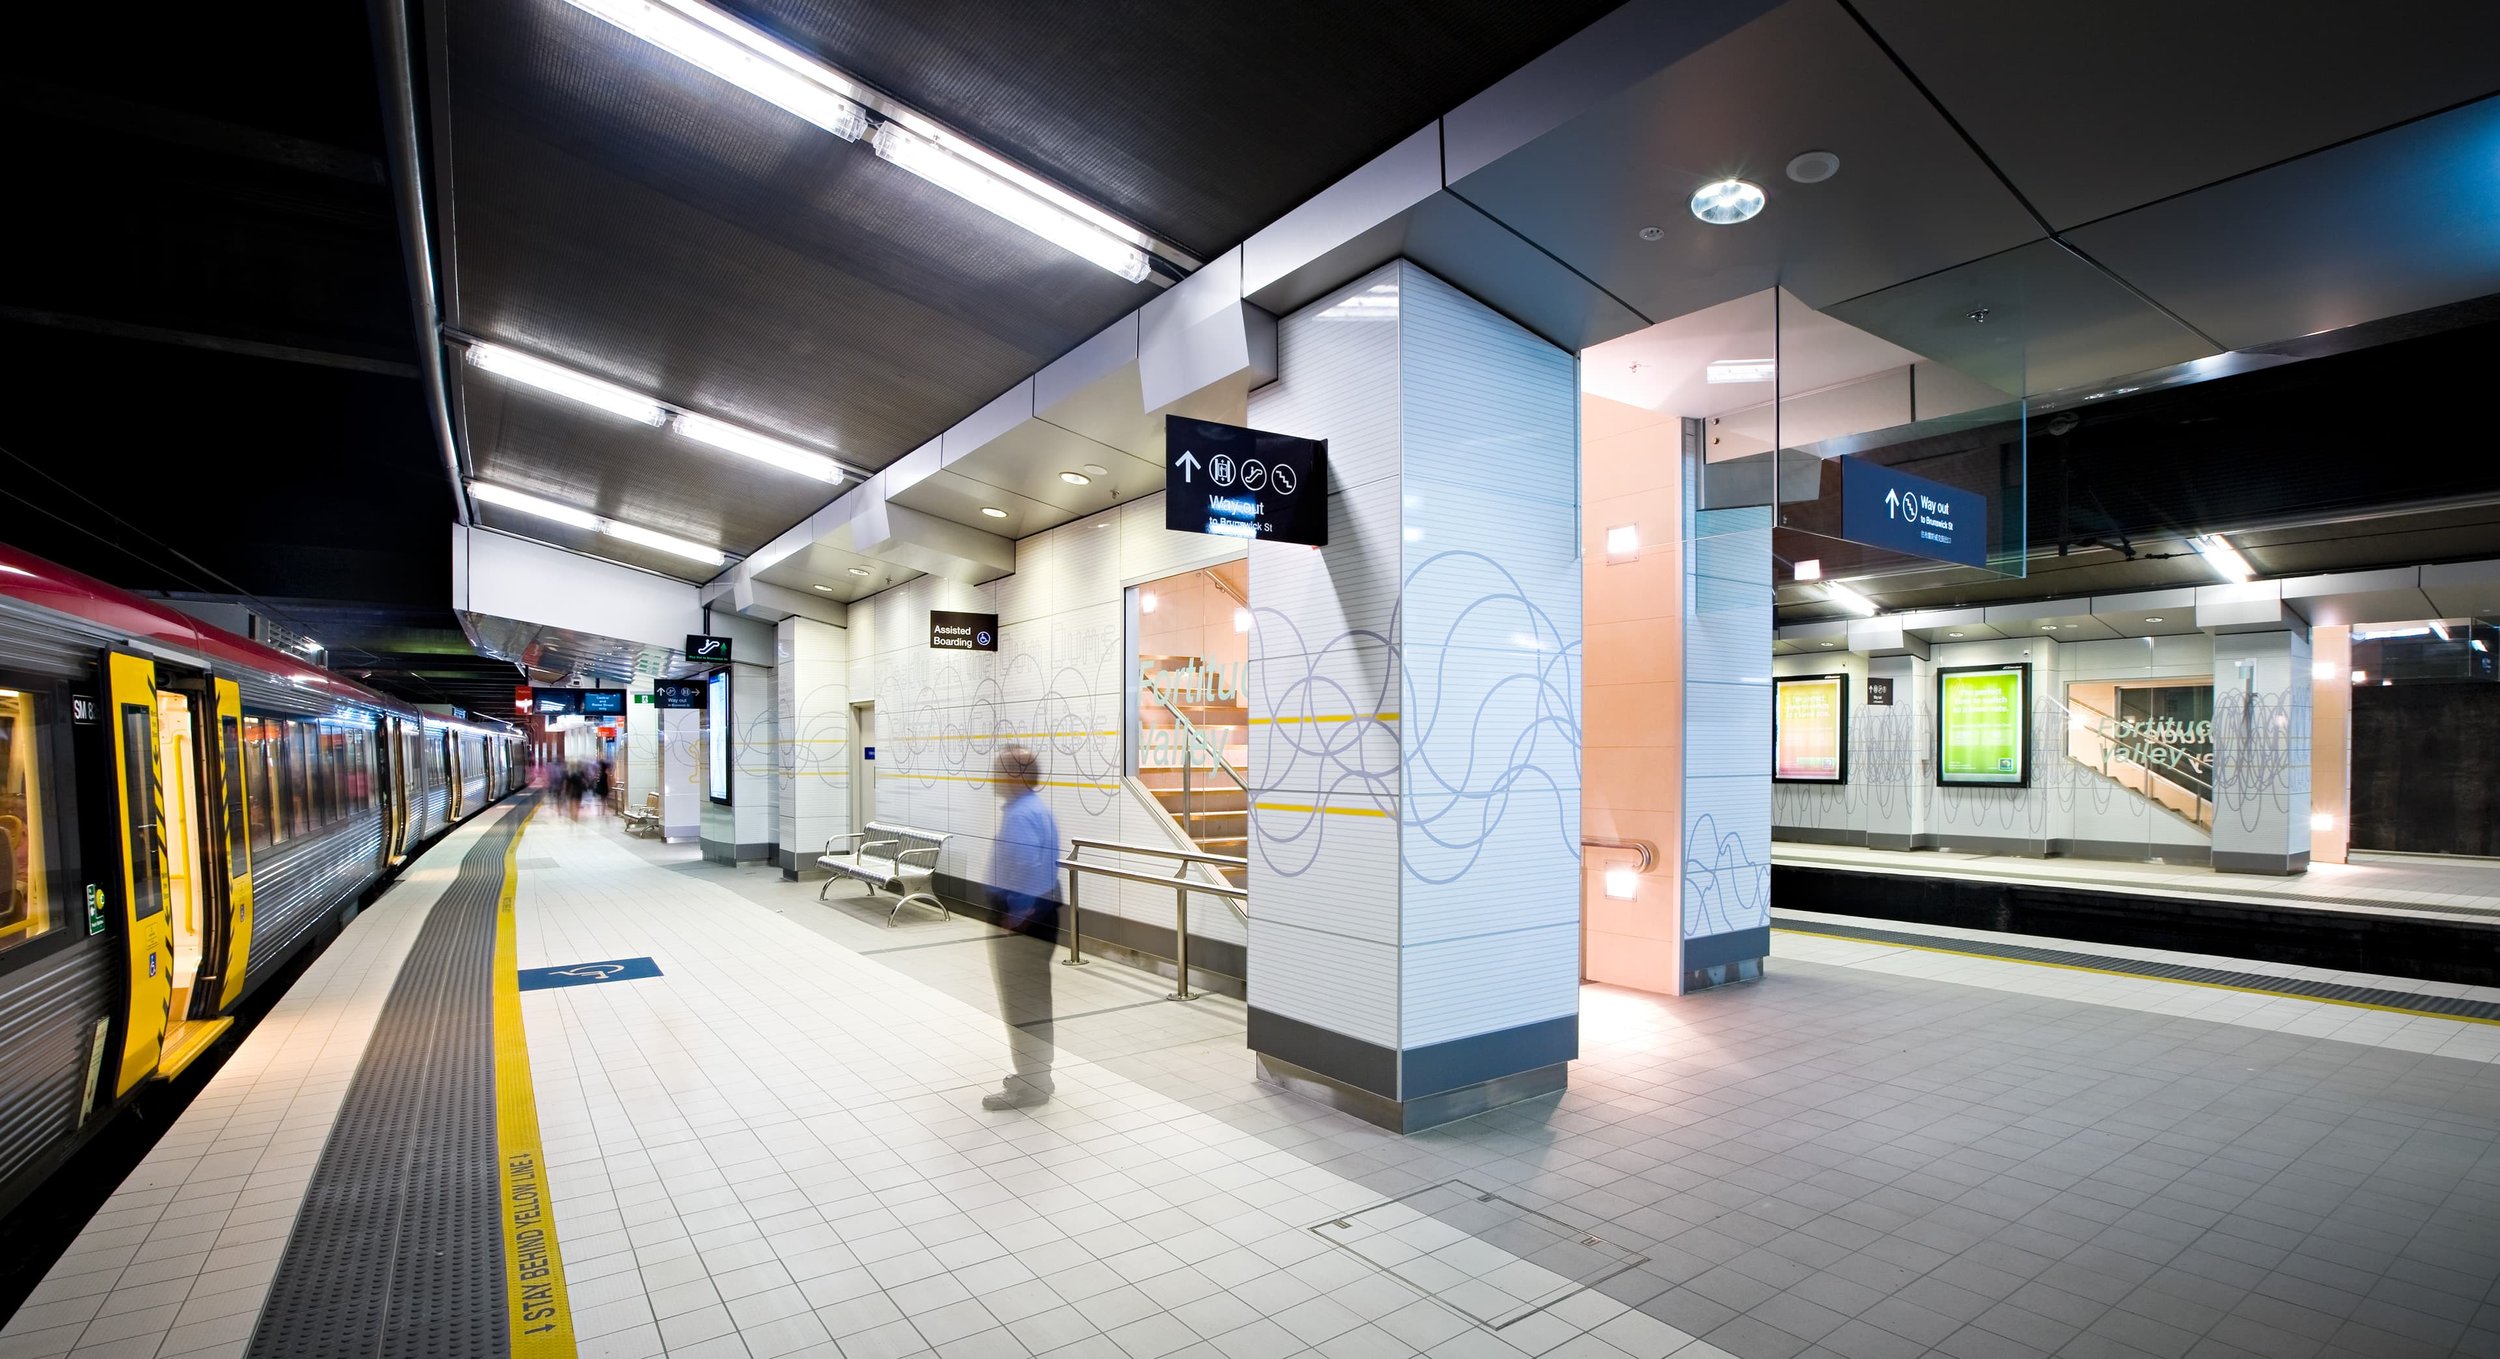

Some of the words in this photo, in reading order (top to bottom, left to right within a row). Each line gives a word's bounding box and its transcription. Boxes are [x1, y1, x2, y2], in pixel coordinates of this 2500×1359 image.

[1209, 494, 1238, 515] Way
[1243, 502, 1264, 515] out
[1920, 494, 1936, 515] Way
[1937, 502, 1949, 515] out
[1209, 517, 1218, 526] to
[1264, 522, 1273, 532] St
[1920, 515, 1926, 524] to
[1926, 516, 1948, 529] Brunswick
[1948, 521, 1954, 531] St
[934, 625, 971, 635] Assisted
[933, 636, 973, 648] Boarding
[74, 699, 87, 719] SM
[509, 1159, 536, 1183] LINE
[512, 1183, 542, 1230] YELLOW
[516, 1228, 550, 1281] BEHIND
[523, 1282, 556, 1322] STAY
